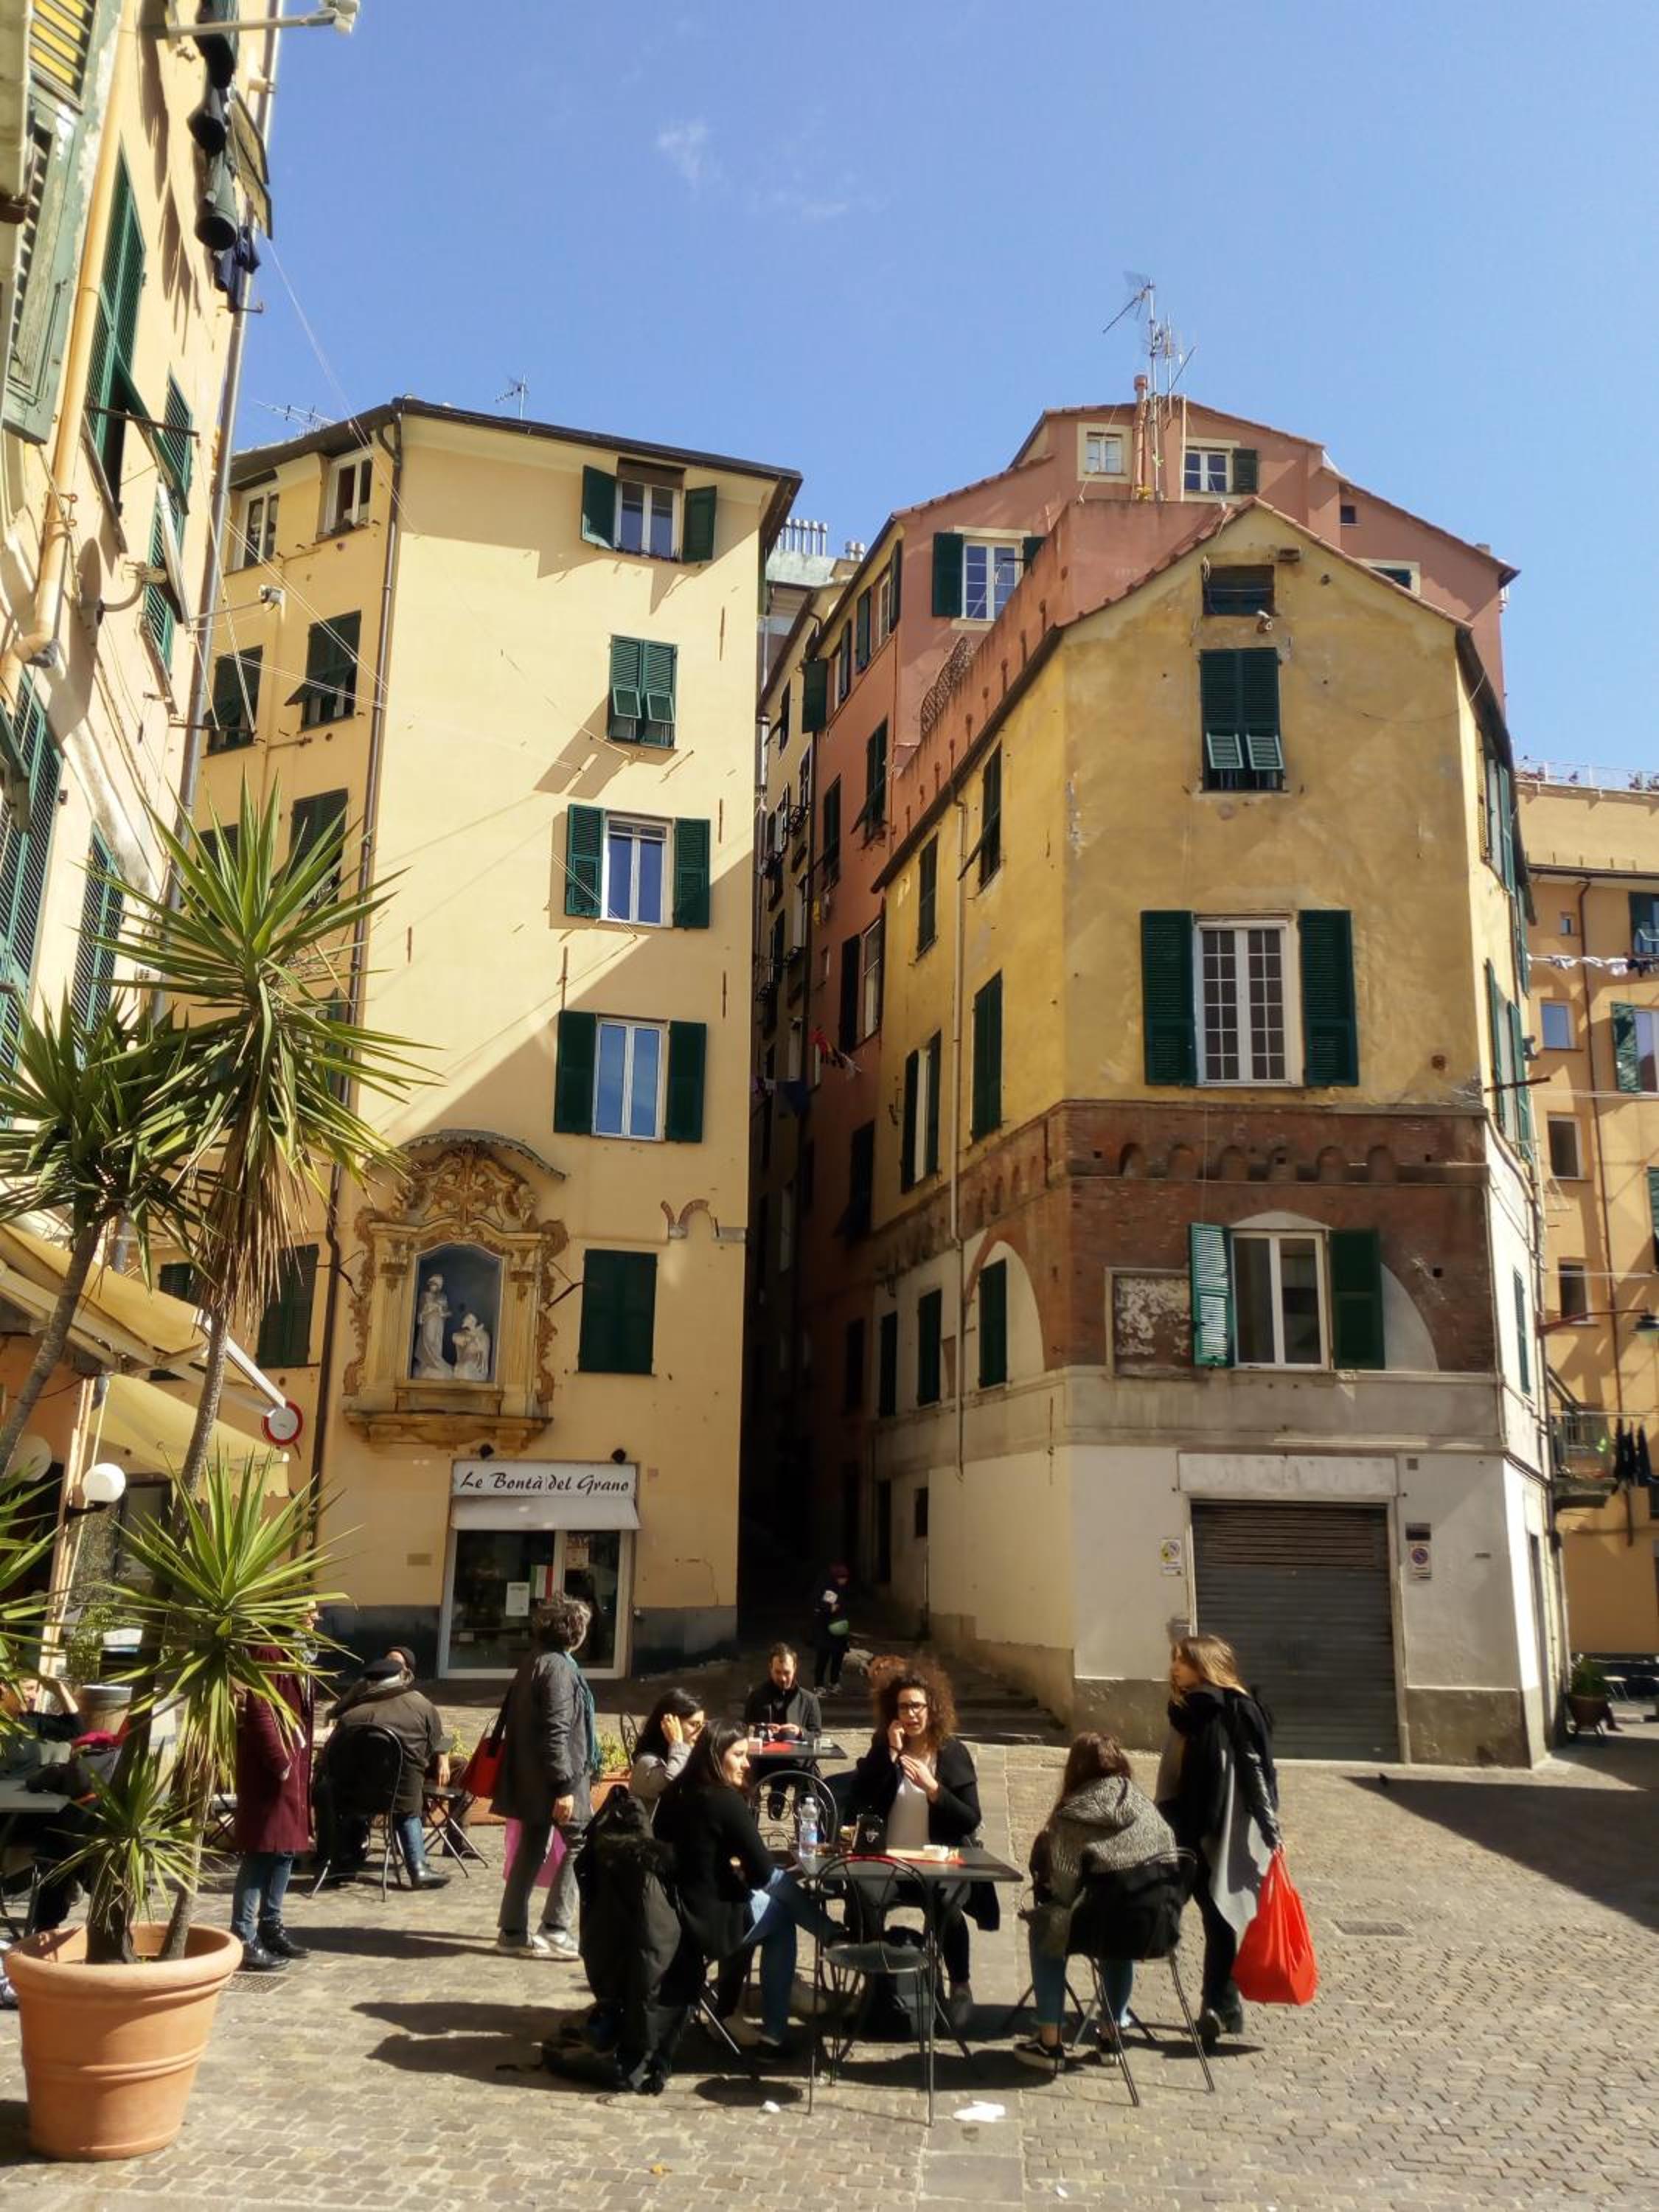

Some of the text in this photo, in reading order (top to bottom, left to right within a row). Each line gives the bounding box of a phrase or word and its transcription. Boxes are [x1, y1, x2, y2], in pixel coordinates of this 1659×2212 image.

[460, 1471, 629, 1495] Le Bontà del Grano
